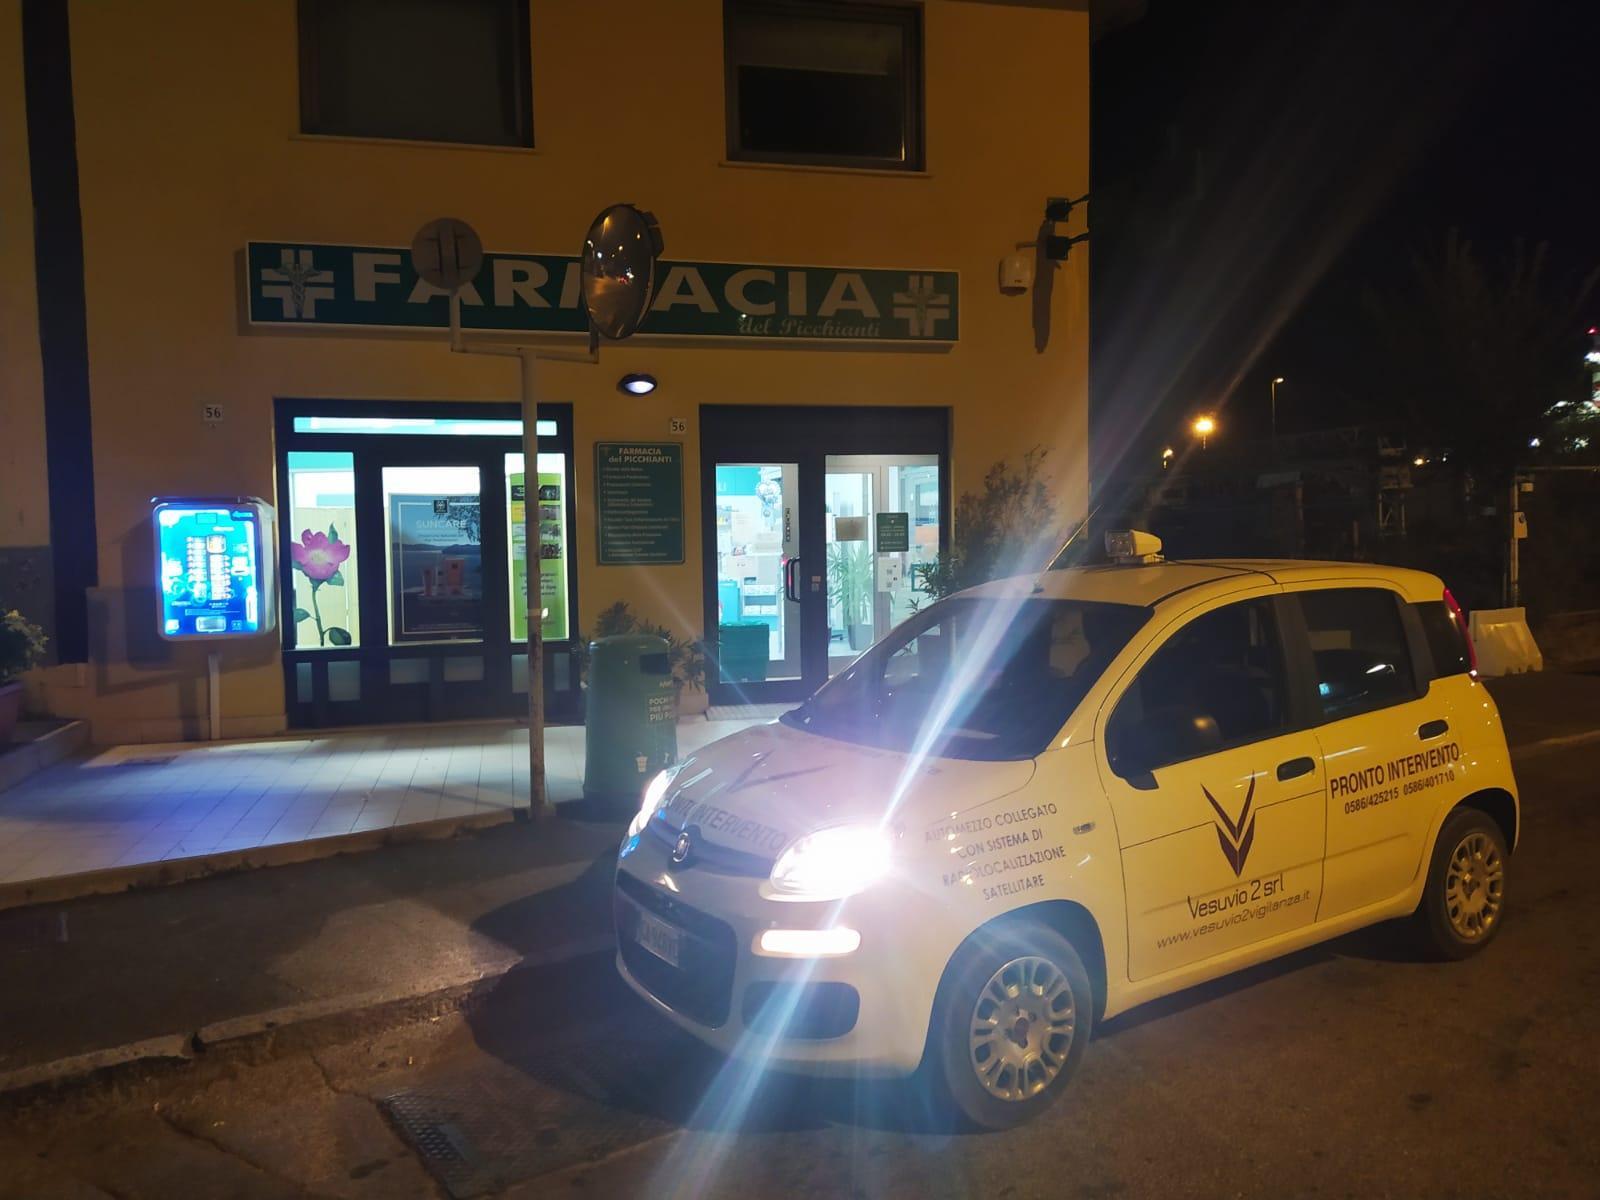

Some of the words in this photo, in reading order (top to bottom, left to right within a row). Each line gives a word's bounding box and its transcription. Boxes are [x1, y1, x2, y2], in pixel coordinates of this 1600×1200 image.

[352, 251, 881, 318] FARACIA
[737, 317, 769, 335] del
[778, 319, 881, 338] Picchianti
[205, 407, 222, 419] 56
[671, 421, 685, 432] 56
[618, 447, 662, 456] FARMACIA
[624, 455, 673, 465] PICCHIANTI
[1330, 765, 1385, 799] PRONTO
[1387, 742, 1460, 782] INTERVENTO
[1344, 787, 1400, 814] 0586/425215
[1403, 770, 1455, 796] 0586/401710
[924, 817, 993, 844] AUTOMEZZO
[994, 803, 1058, 828] COLLEGATO
[957, 844, 985, 859] CON
[986, 831, 1030, 852] SISTEMA
[1031, 828, 1043, 841] DI
[982, 874, 1045, 901] SATELLITARE
[1187, 889, 1248, 920] Vesuvio
[1250, 879, 1262, 901] 2
[1263, 872, 1284, 897] srl
[1156, 890, 1311, 950] www.vesuvio2vigilanza.it
